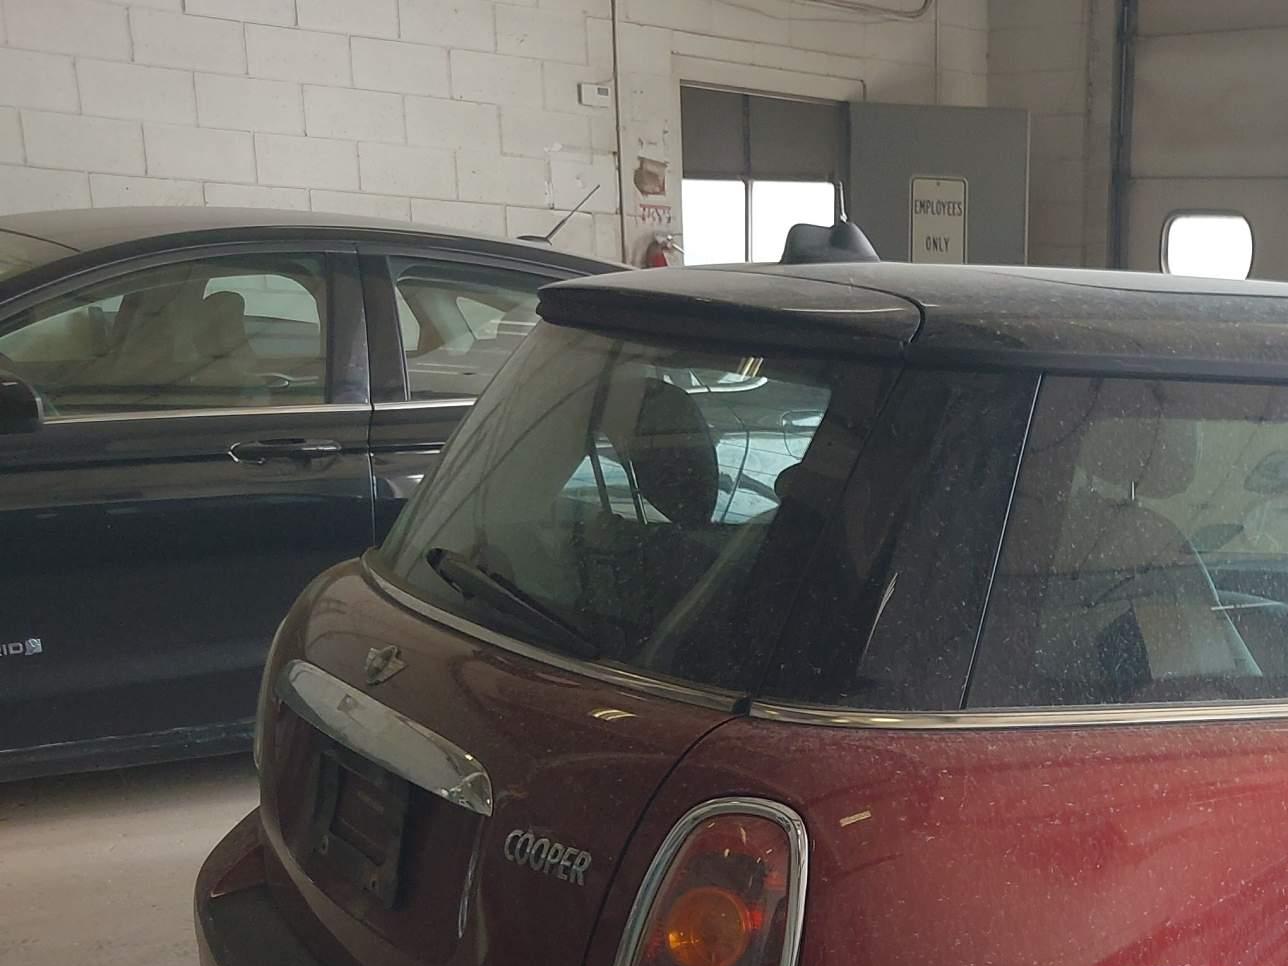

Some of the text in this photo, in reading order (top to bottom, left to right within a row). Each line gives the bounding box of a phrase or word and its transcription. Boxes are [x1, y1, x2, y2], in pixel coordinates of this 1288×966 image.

[914, 199, 963, 216] EMPLOYEES
[925, 235, 950, 253] ONLY
[0, 642, 23, 656] ID
[504, 829, 592, 886] COOPER
